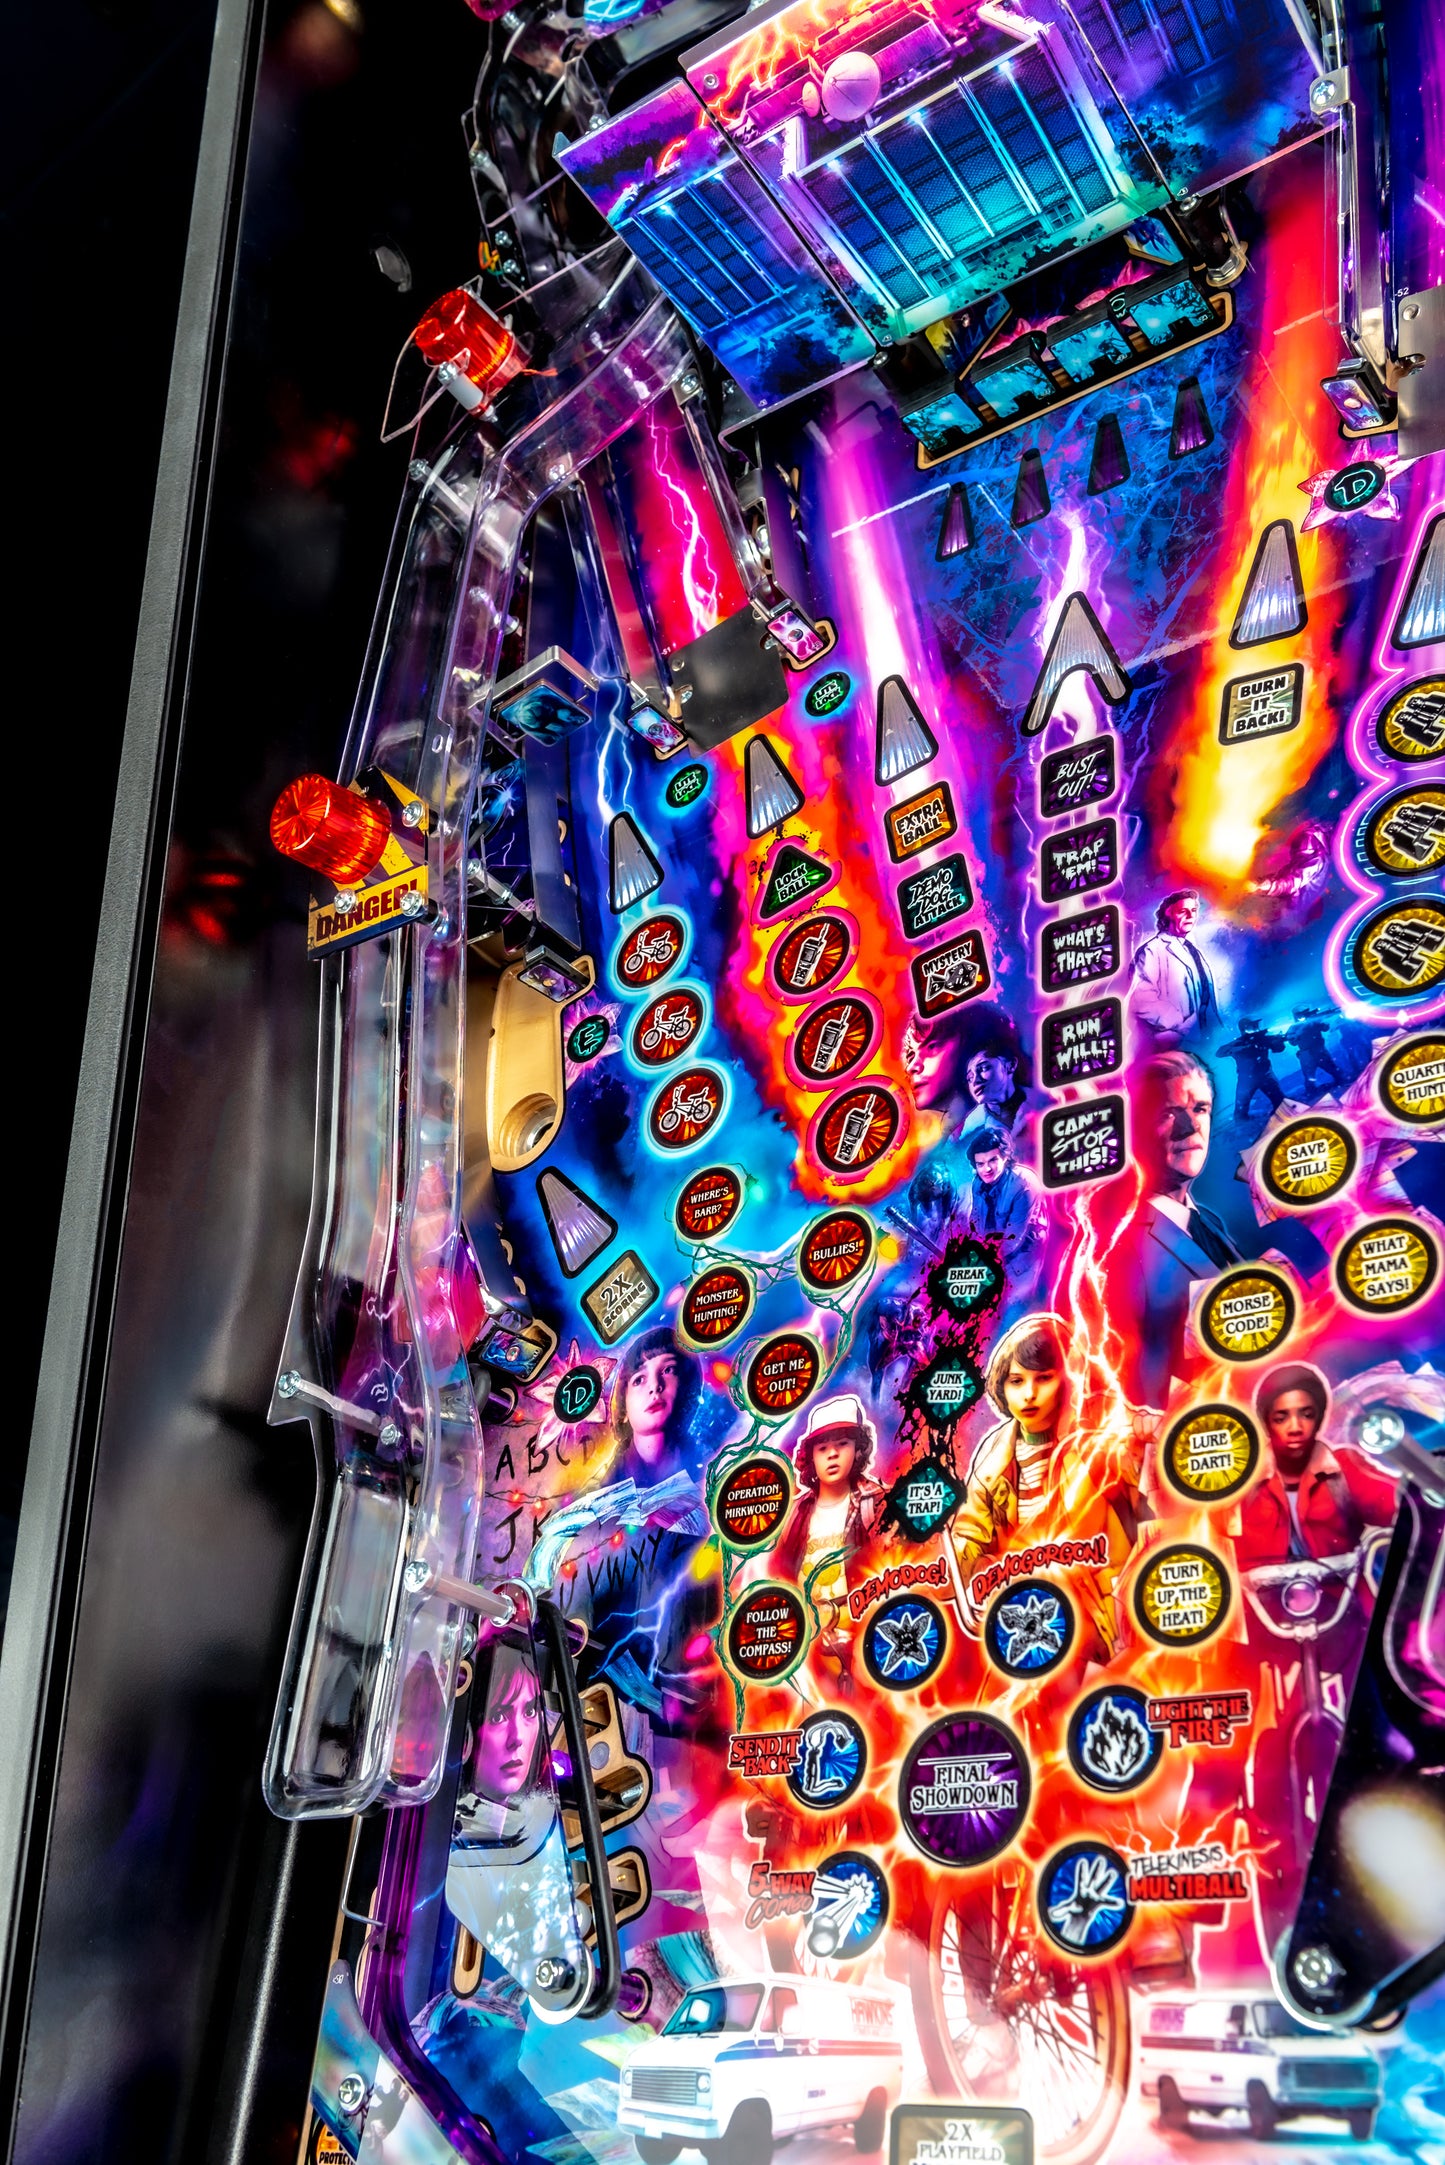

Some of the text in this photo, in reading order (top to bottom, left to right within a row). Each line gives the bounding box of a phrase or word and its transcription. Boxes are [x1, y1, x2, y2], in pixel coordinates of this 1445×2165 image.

[815, 680, 838, 700] LITE
[1240, 675, 1286, 698] BURN
[815, 687, 841, 709] LOCK
[1253, 697, 1271, 712] IT
[1235, 710, 1285, 732] BACK!
[1051, 748, 1105, 783] BUST
[675, 772, 697, 792] LITE
[675, 778, 700, 801] LOCK
[1058, 768, 1097, 799] OUT!
[895, 798, 944, 834] EXTRA
[902, 816, 943, 847] BALL
[1052, 838, 1105, 870] TRAP
[775, 863, 807, 891] LOCK
[778, 876, 810, 902] BALL
[908, 868, 953, 909] DEMO
[921, 884, 955, 916] DOG
[913, 895, 966, 928] ATTACK
[1053, 924, 1106, 951] WHAT'S
[923, 940, 974, 978] MYSTERY
[1057, 949, 1103, 974] THAT?
[1062, 1018, 1100, 1046] RUN
[1056, 1040, 1108, 1070] WILL!
[1053, 1108, 1112, 1137] CAN'T
[1051, 1125, 1114, 1158] STOP
[1290, 1142, 1327, 1160] SAVE
[1056, 1146, 1108, 1173] THIS!
[1290, 1162, 1328, 1181] WILL!
[690, 1186, 729, 1205] WHERE'S
[694, 1204, 722, 1219] BARB?
[813, 1241, 859, 1262] BULLIES!
[1363, 1236, 1405, 1255] WHAT
[949, 1268, 986, 1281] BREAK
[1365, 1257, 1408, 1276] MAMA
[600, 1273, 632, 1309] 2X
[696, 1288, 739, 1306] MONSTER
[950, 1284, 979, 1296] OUT!
[1366, 1279, 1409, 1298] SAYS!
[603, 1282, 646, 1327] SCORING
[694, 1304, 738, 1323] HUNTING!
[1223, 1295, 1271, 1315] MORSE
[1225, 1316, 1269, 1335] CODE!
[763, 1357, 805, 1376] GET ME
[769, 1377, 796, 1393] OUT!
[933, 1373, 963, 1385] JUNK
[929, 1389, 962, 1401] YARD!
[1192, 1432, 1228, 1450] LURE
[1190, 1454, 1231, 1472] DART!
[727, 1484, 780, 1501] OPERATION
[910, 1484, 943, 1498] IT'S A
[725, 1502, 779, 1519] MIRKWOOD!
[908, 1501, 940, 1514] TRAP!
[971, 1535, 1107, 1606] DEMOGORGON!
[1162, 1563, 1199, 1580] TURN
[848, 1556, 948, 1620] DEMODOG!
[1157, 1586, 1208, 1604] UP THE
[746, 1607, 789, 1624] FOLLOW
[1167, 1610, 1208, 1627] HEAT!
[756, 1625, 777, 1640] THE
[739, 1641, 792, 1658] COMPASS!
[1149, 1697, 1248, 1722] LIGHT THE
[1170, 1718, 1232, 1748] FIRE
[731, 1734, 801, 1762] SEND IT
[743, 1755, 793, 1777] BACK
[936, 1764, 993, 1786] FINAL
[911, 1782, 1015, 1811] SHOWDOWN
[1131, 1846, 1223, 1875] TELEKINESIS
[1129, 1871, 1247, 1902] MULTIBALL
[946, 2122, 973, 2141] 2X
[919, 2143, 1003, 2161] PLAYFIELD
